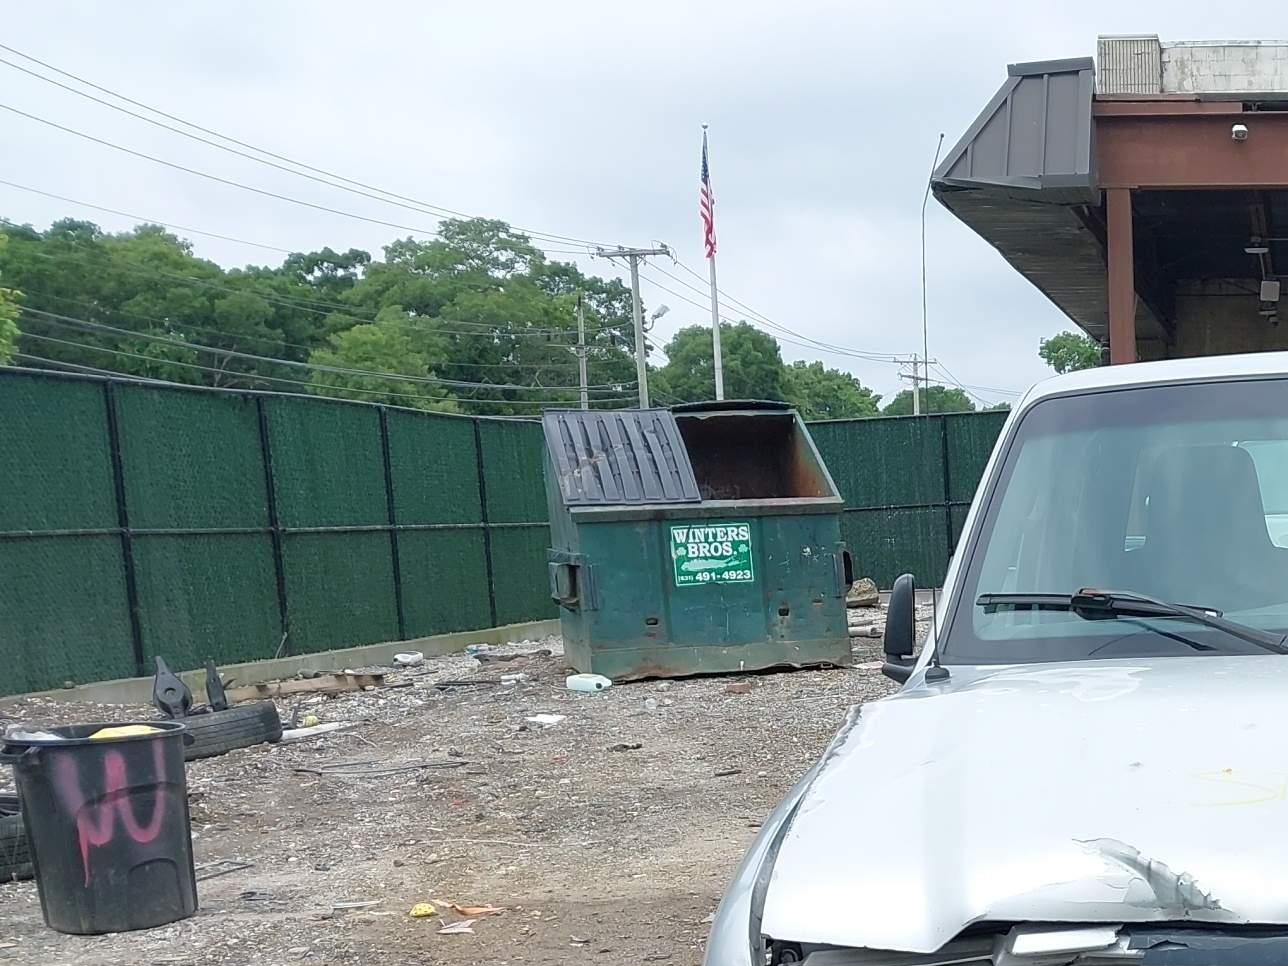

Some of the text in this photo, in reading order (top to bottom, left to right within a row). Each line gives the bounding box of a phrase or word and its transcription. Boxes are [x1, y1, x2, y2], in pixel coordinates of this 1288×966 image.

[673, 526, 749, 543] WINTERS
[687, 542, 737, 557] BROS.
[695, 570, 751, 581] 491-4923
